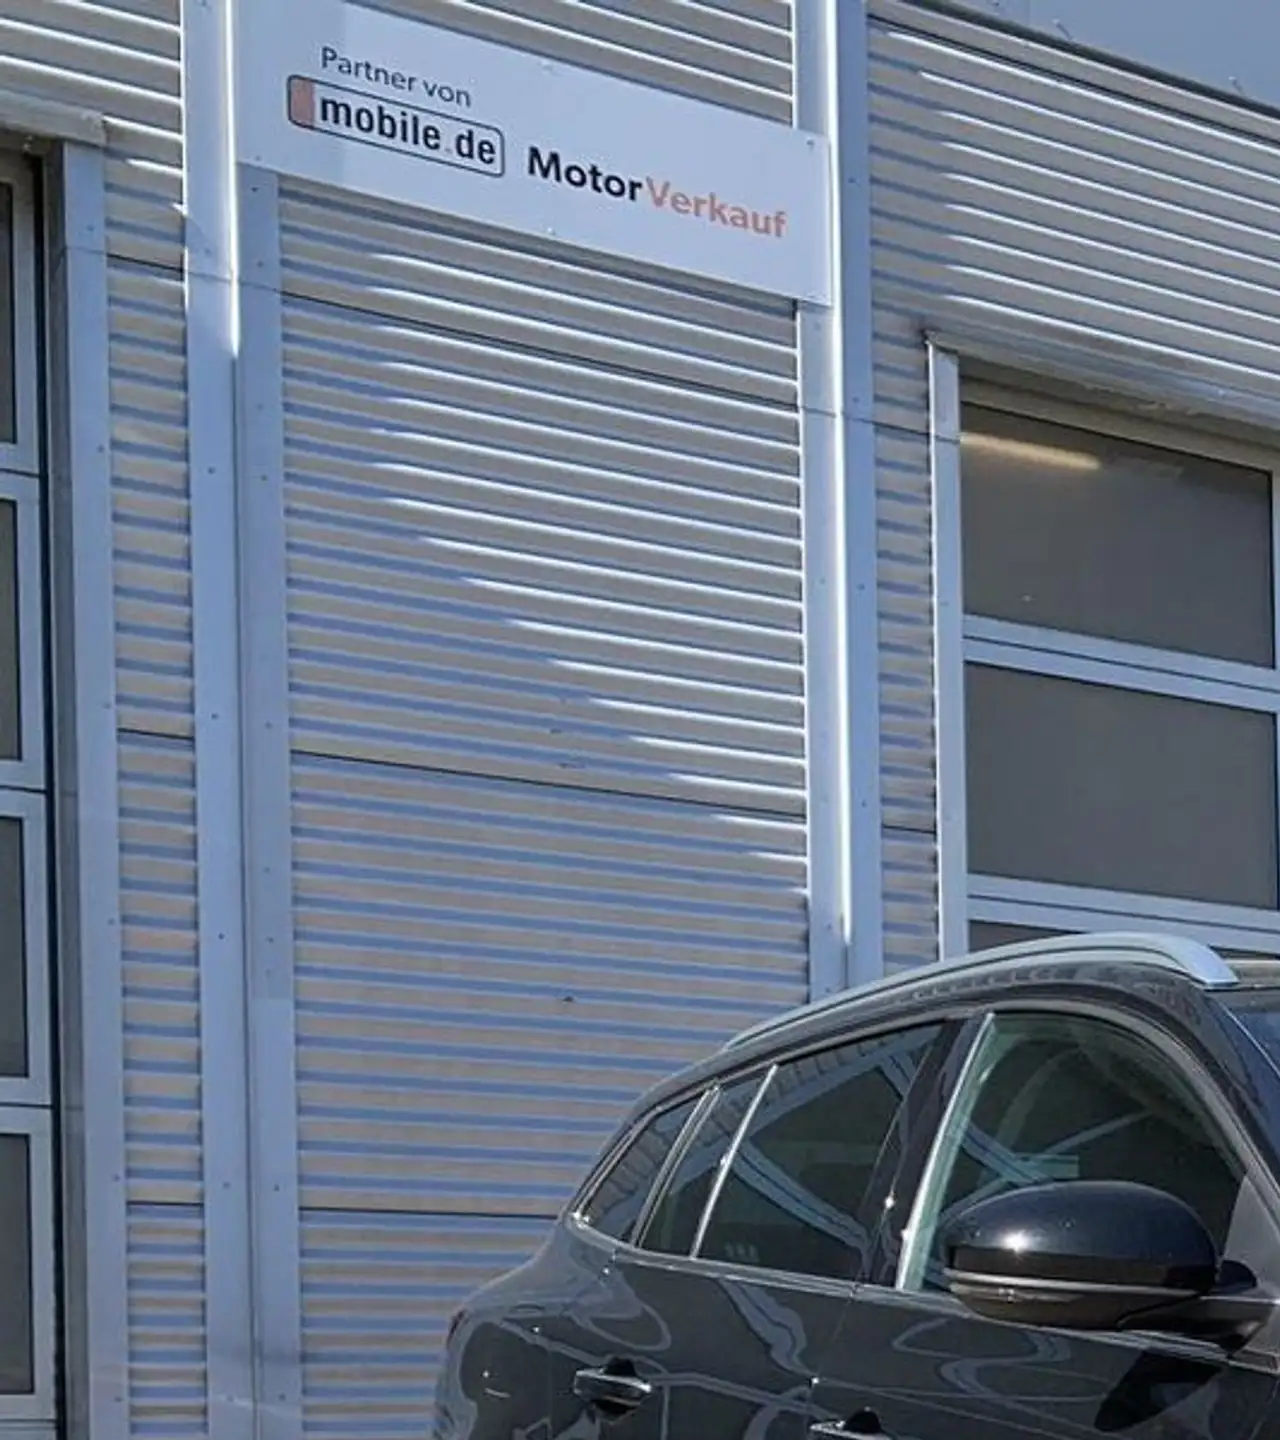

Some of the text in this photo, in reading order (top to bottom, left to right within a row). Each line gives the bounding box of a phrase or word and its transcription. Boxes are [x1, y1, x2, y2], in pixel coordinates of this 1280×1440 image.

[320, 45, 472, 108] Partner von
[319, 96, 497, 166] mobile.de
